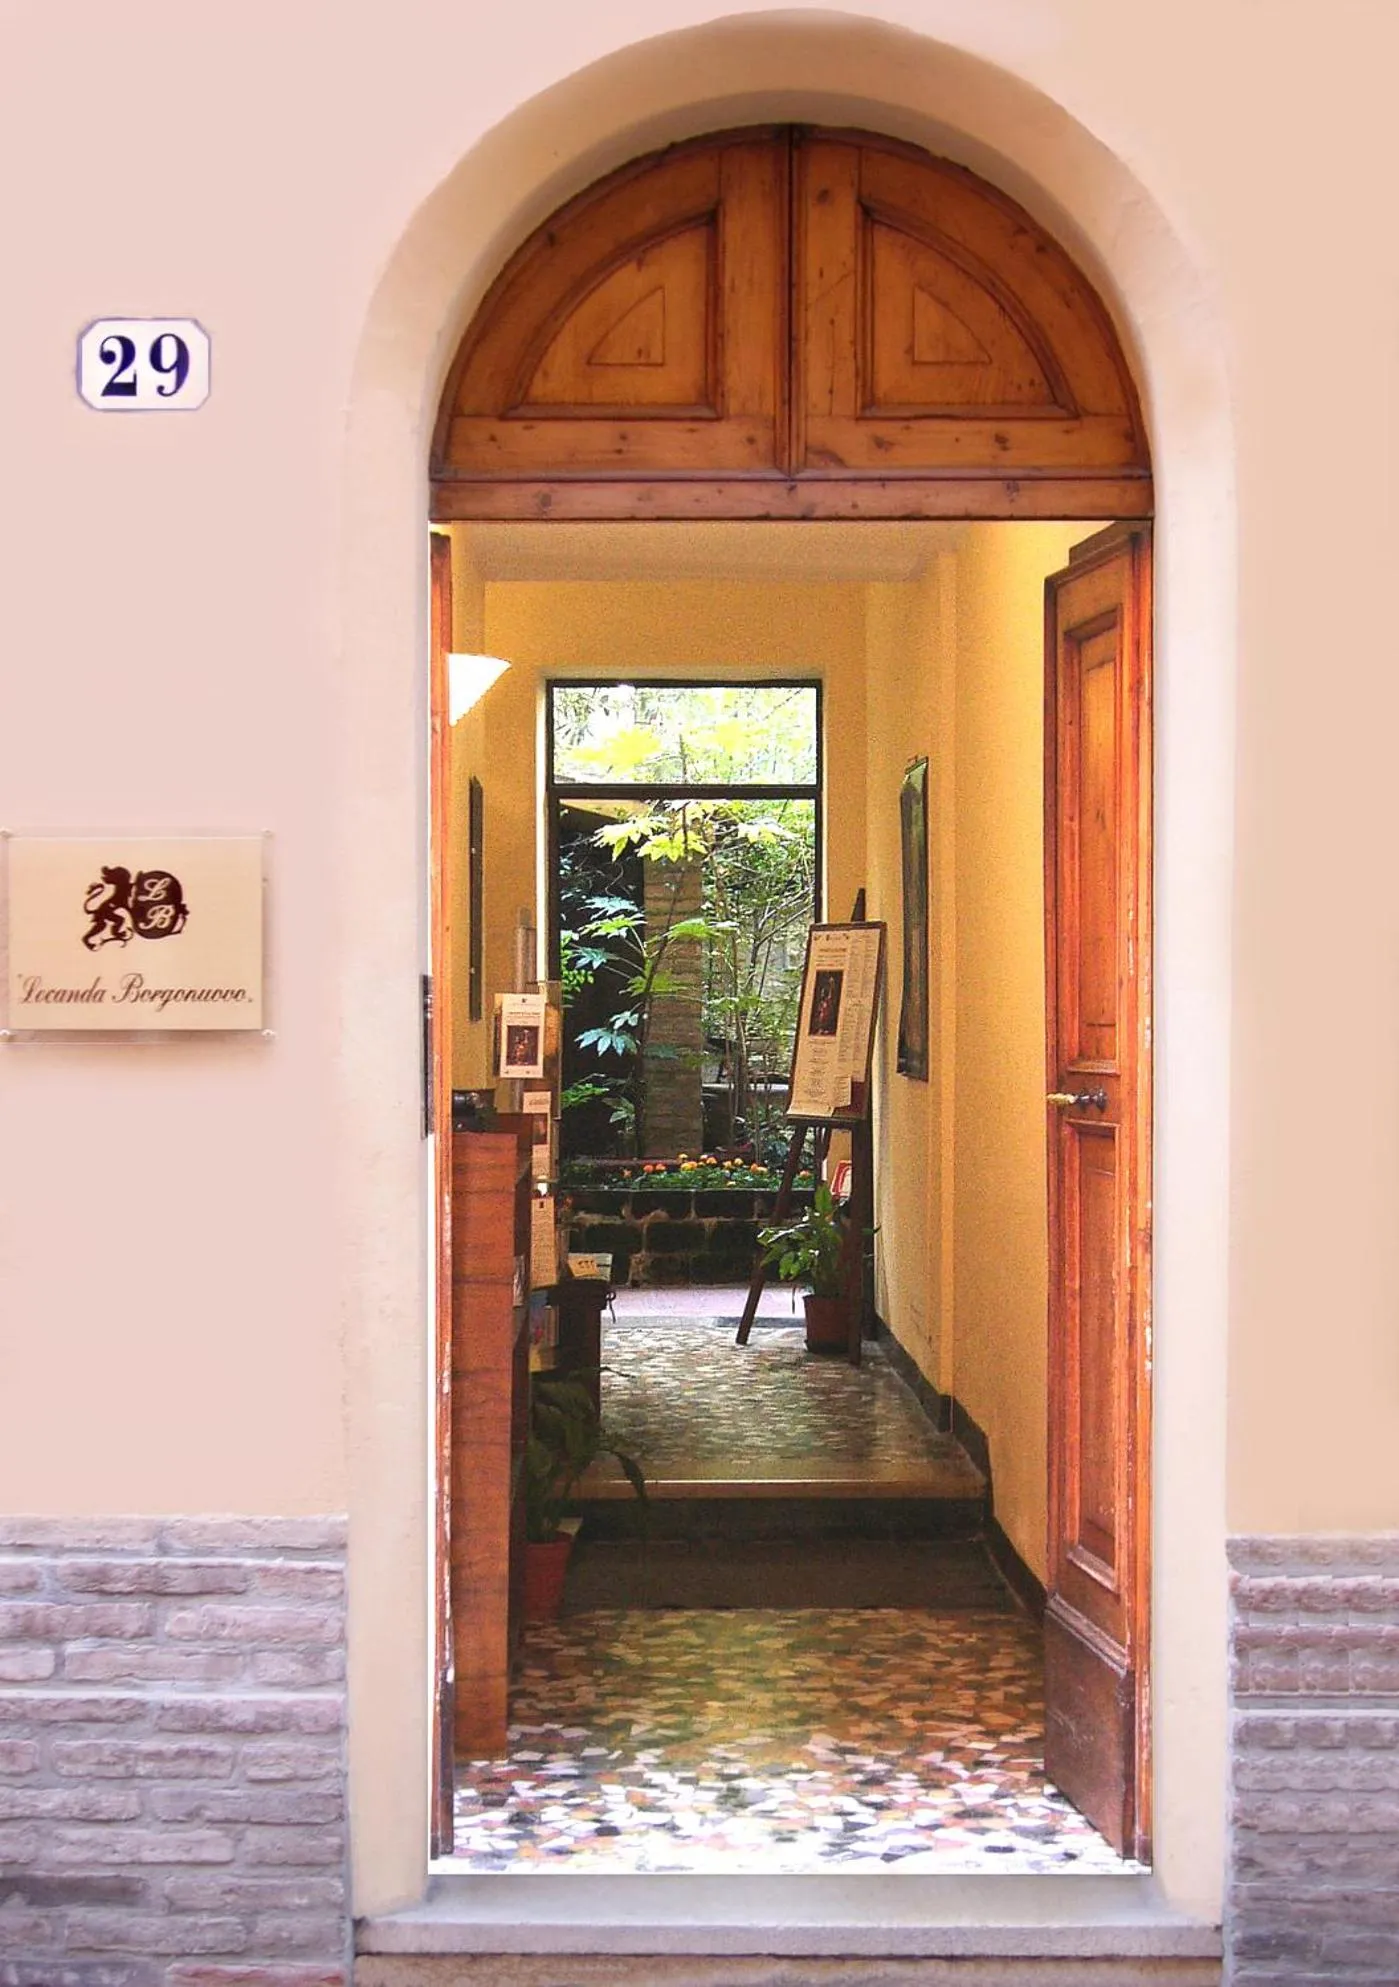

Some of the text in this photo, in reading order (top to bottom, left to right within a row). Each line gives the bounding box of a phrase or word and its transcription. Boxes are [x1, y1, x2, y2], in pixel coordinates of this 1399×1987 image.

[99, 332, 190, 397] 29
[138, 904, 176, 930] B
[20, 974, 107, 1004] Locanda
